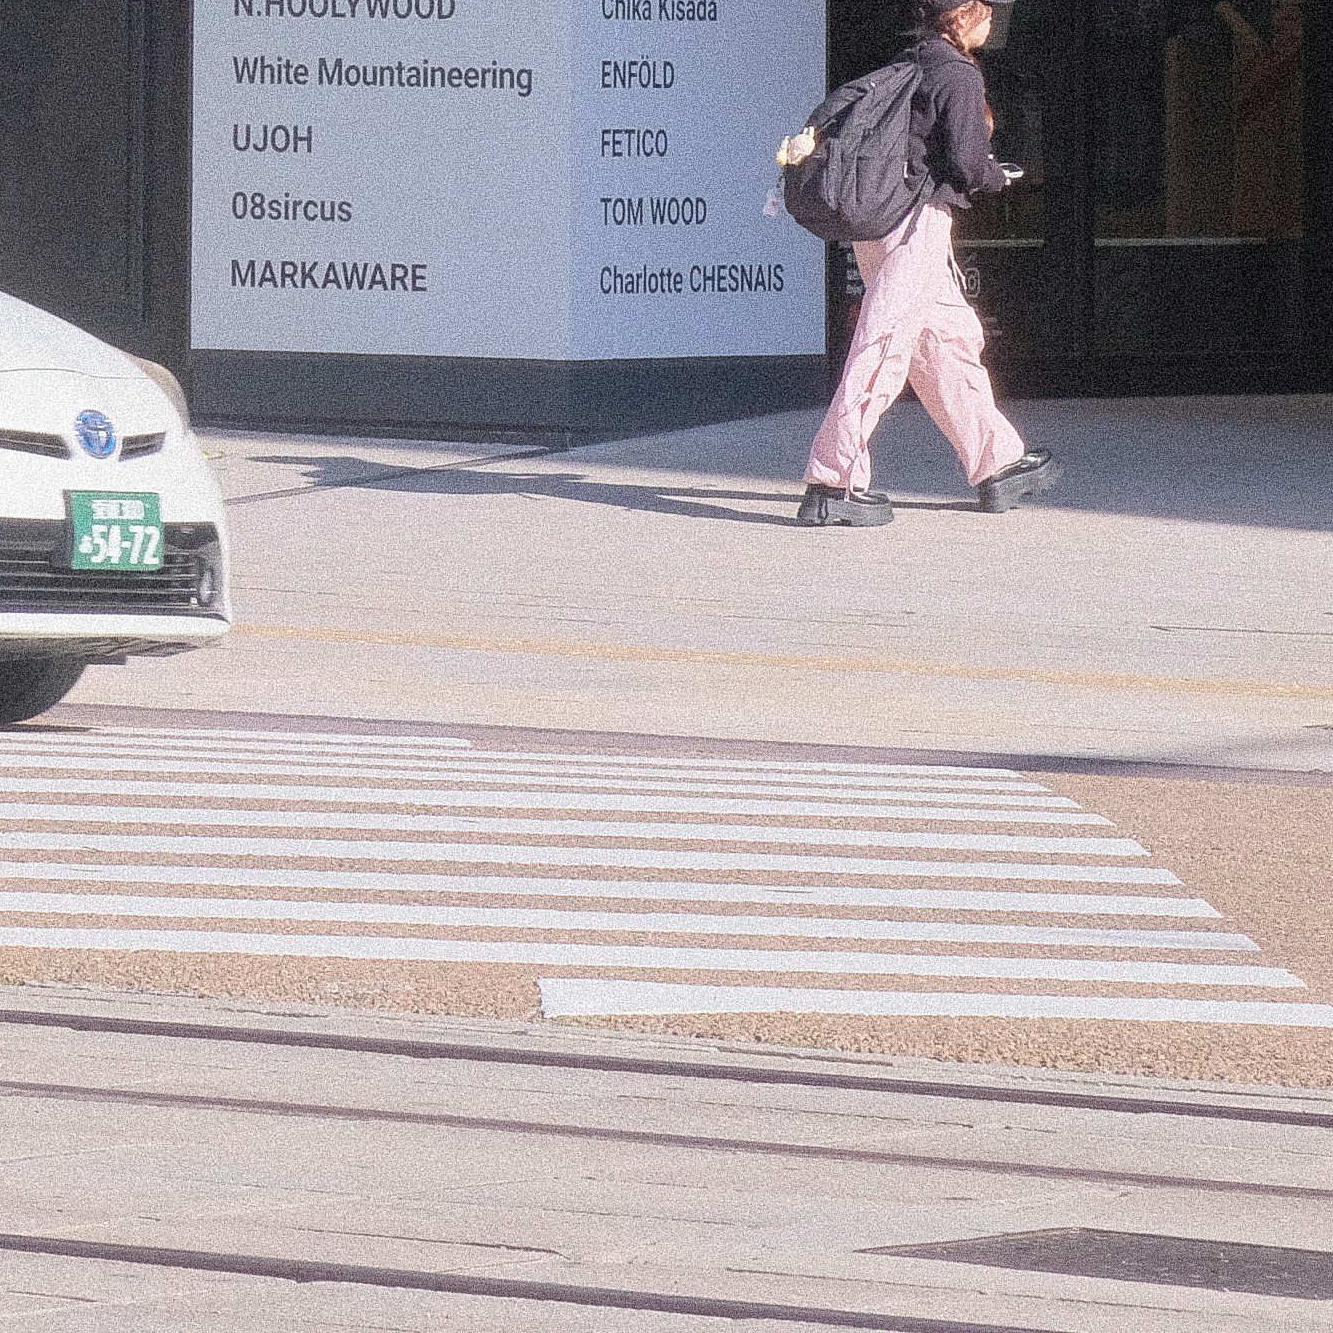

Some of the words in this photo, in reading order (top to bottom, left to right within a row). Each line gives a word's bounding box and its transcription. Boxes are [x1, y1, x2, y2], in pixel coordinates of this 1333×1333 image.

[232, 55, 309, 85] White
[318, 57, 533, 95] Mountaineering
[232, 124, 313, 153] UJOH
[601, 129, 668, 157] FETICO
[231, 191, 352, 222] 08sircus
[600, 197, 643, 226] TOM
[650, 197, 707, 225] WOOD
[231, 259, 427, 292] MARKAWARE
[600, 266, 683, 295] Charlotte
[689, 264, 784, 293] CHESNAIS
